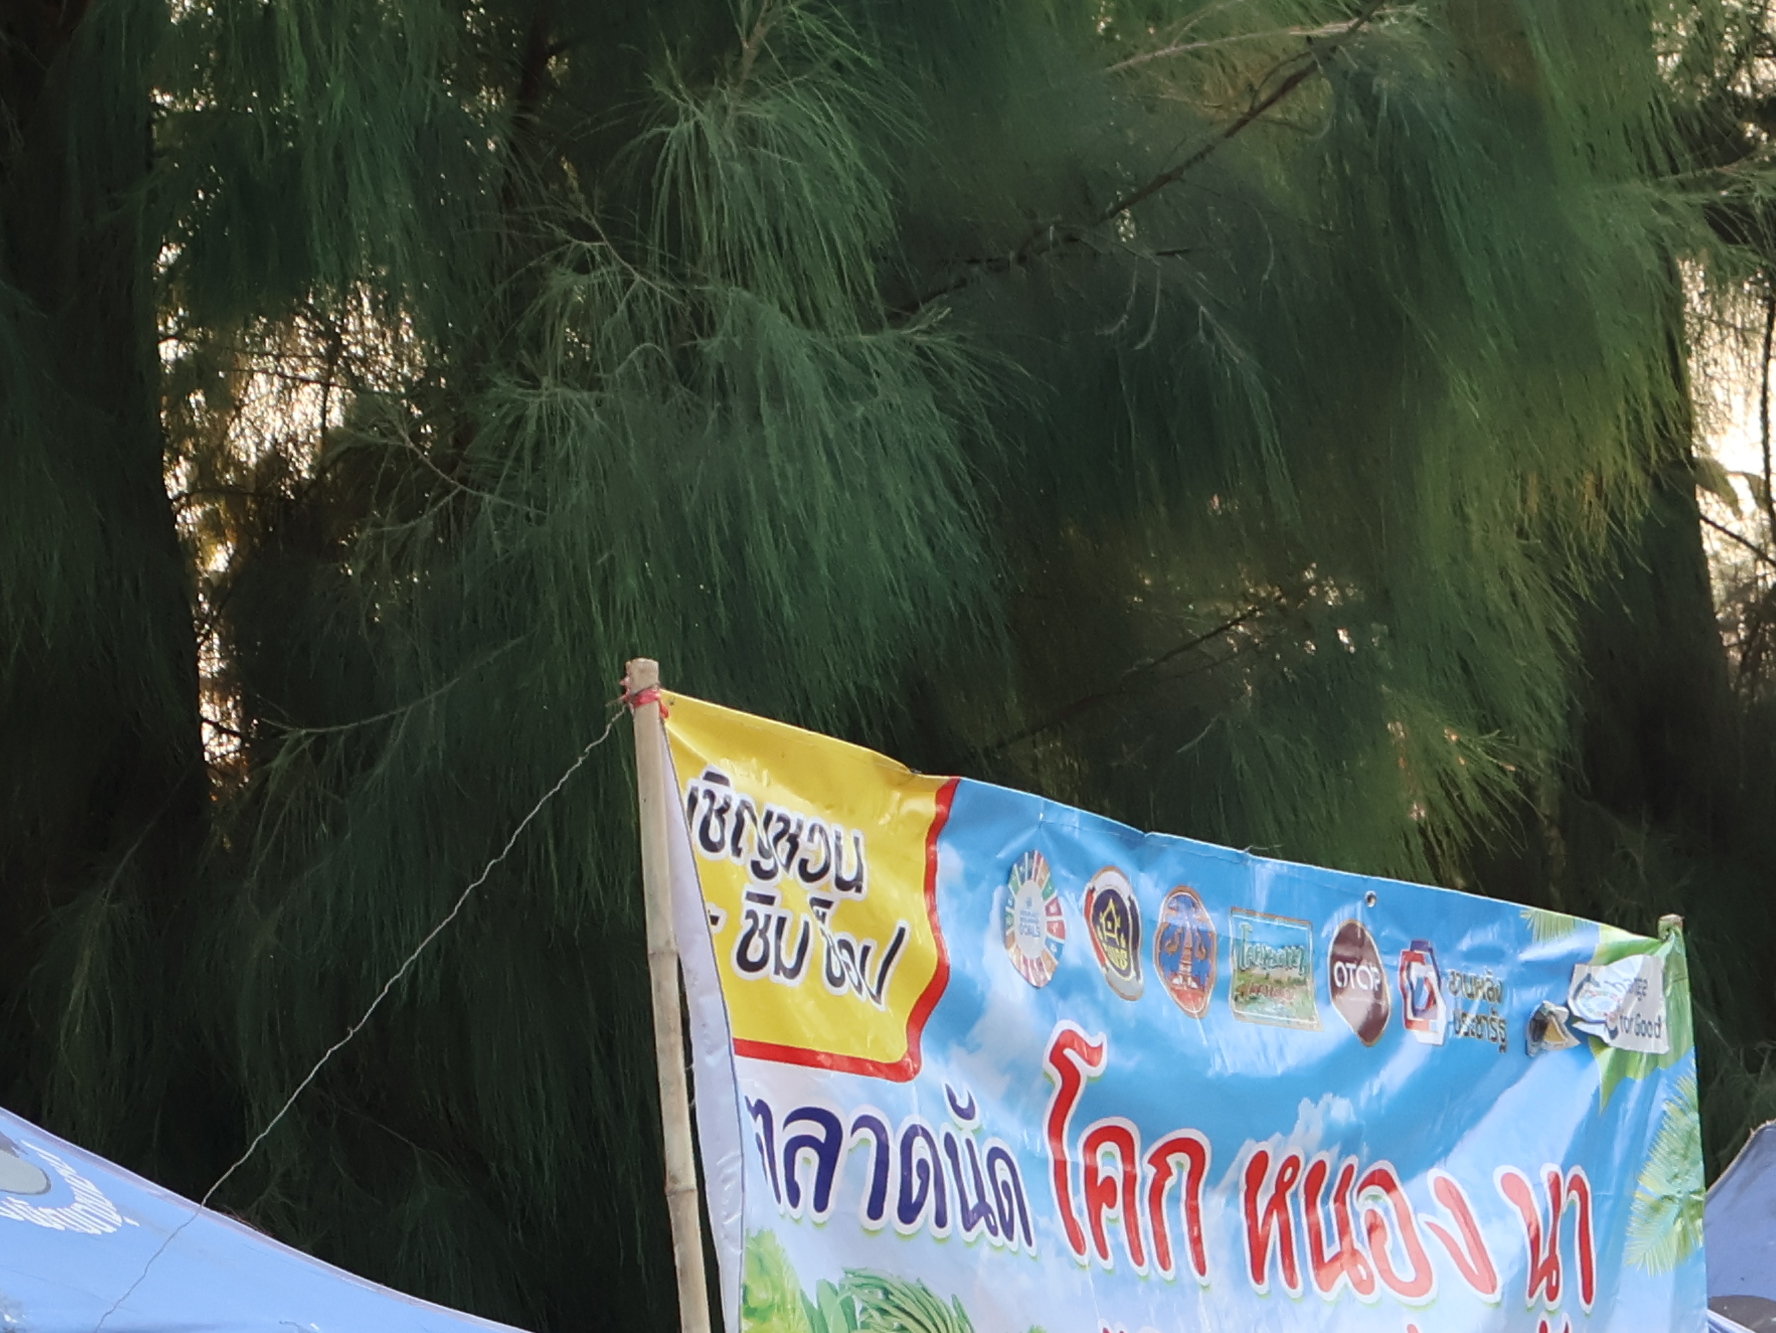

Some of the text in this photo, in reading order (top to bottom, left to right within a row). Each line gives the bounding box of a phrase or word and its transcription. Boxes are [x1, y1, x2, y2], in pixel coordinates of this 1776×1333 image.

[1048, 1028, 1207, 1278] โคก
[1244, 1149, 1498, 1299] หนอง
[1500, 1169, 1595, 1306] นา
